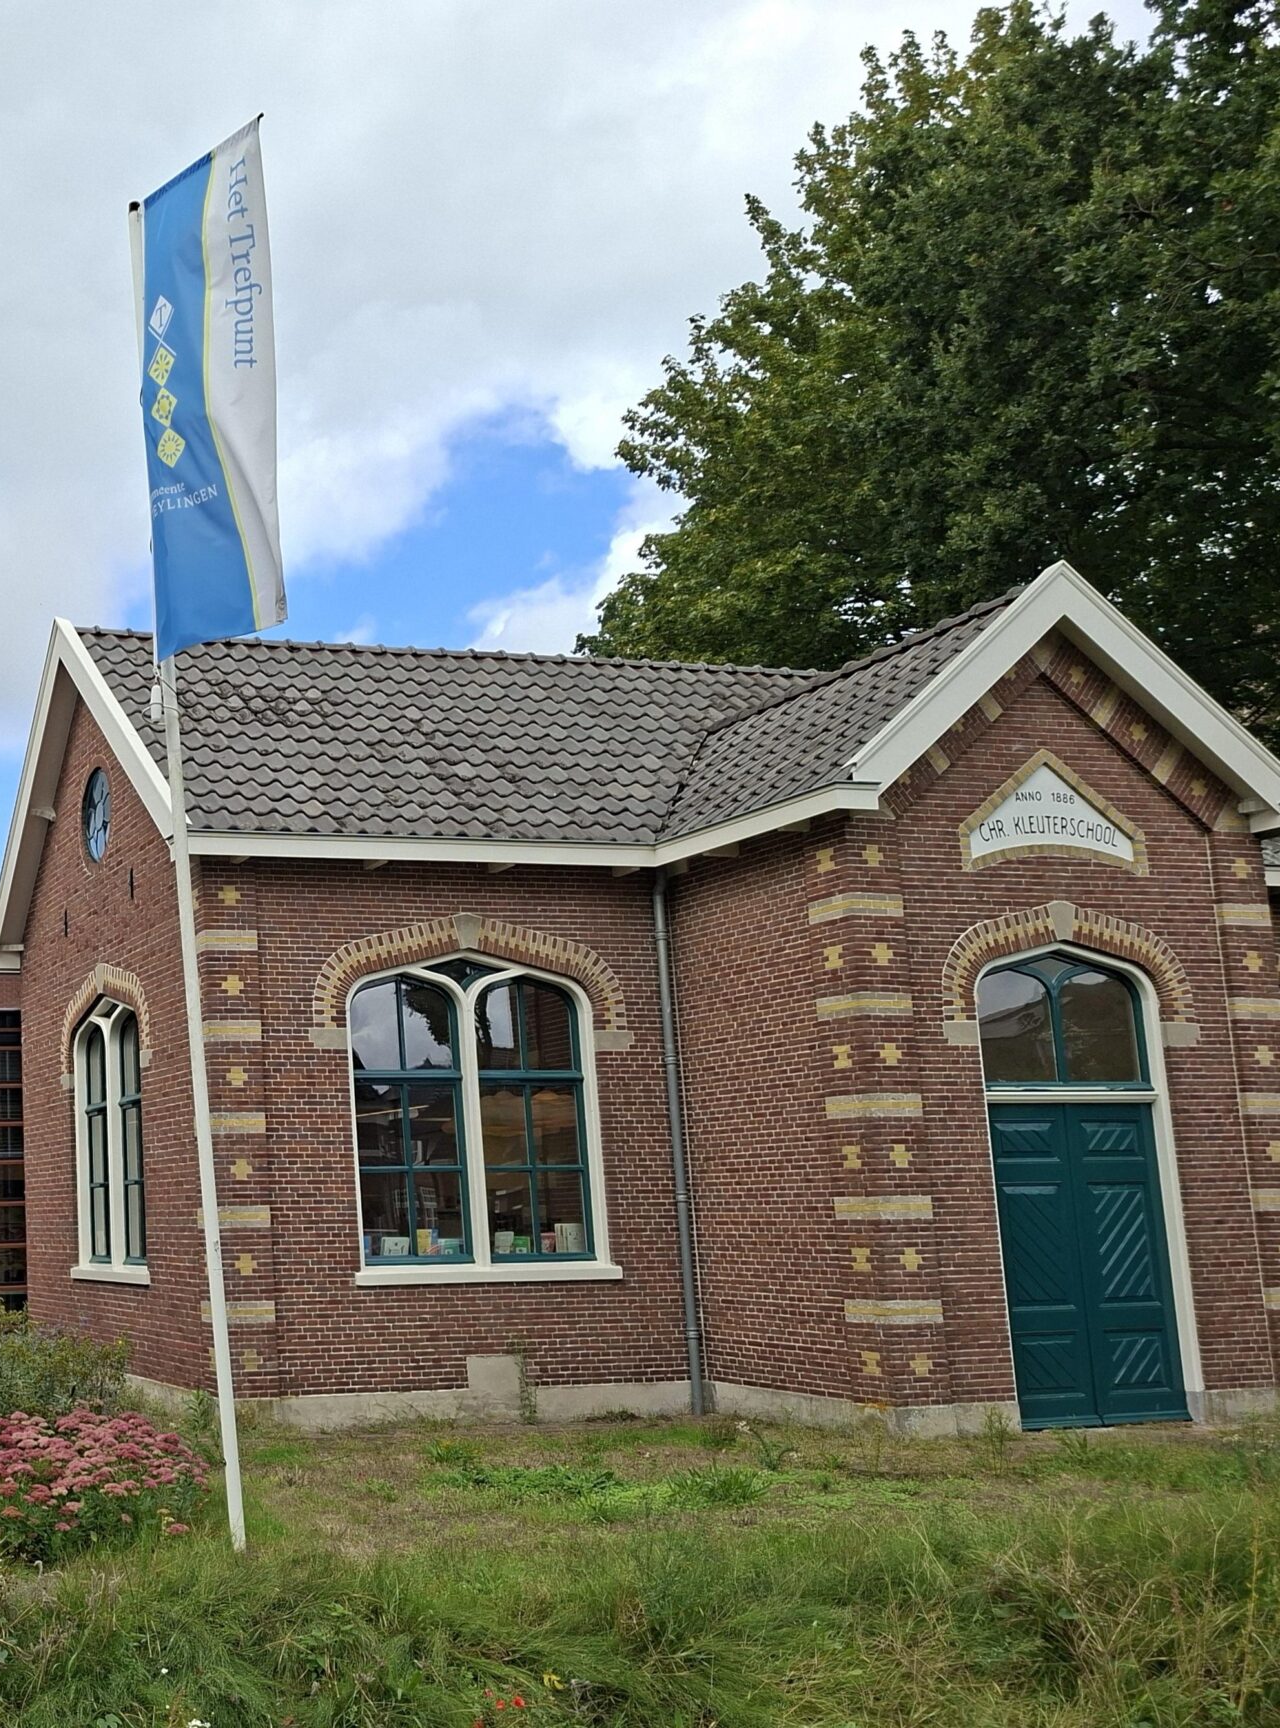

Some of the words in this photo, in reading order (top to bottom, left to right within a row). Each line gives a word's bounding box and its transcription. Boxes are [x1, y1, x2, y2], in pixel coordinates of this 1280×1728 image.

[227, 155, 249, 222] Het
[225, 224, 263, 369] Trefpunt
[151, 482, 186, 499] meente
[152, 484, 218, 519] EYLINGEN
[1015, 791, 1042, 802] ANNO
[1051, 792, 1075, 805] 1886
[979, 819, 1010, 842] CHR.
[1012, 815, 1118, 848] KLEUTERSCHOOL
